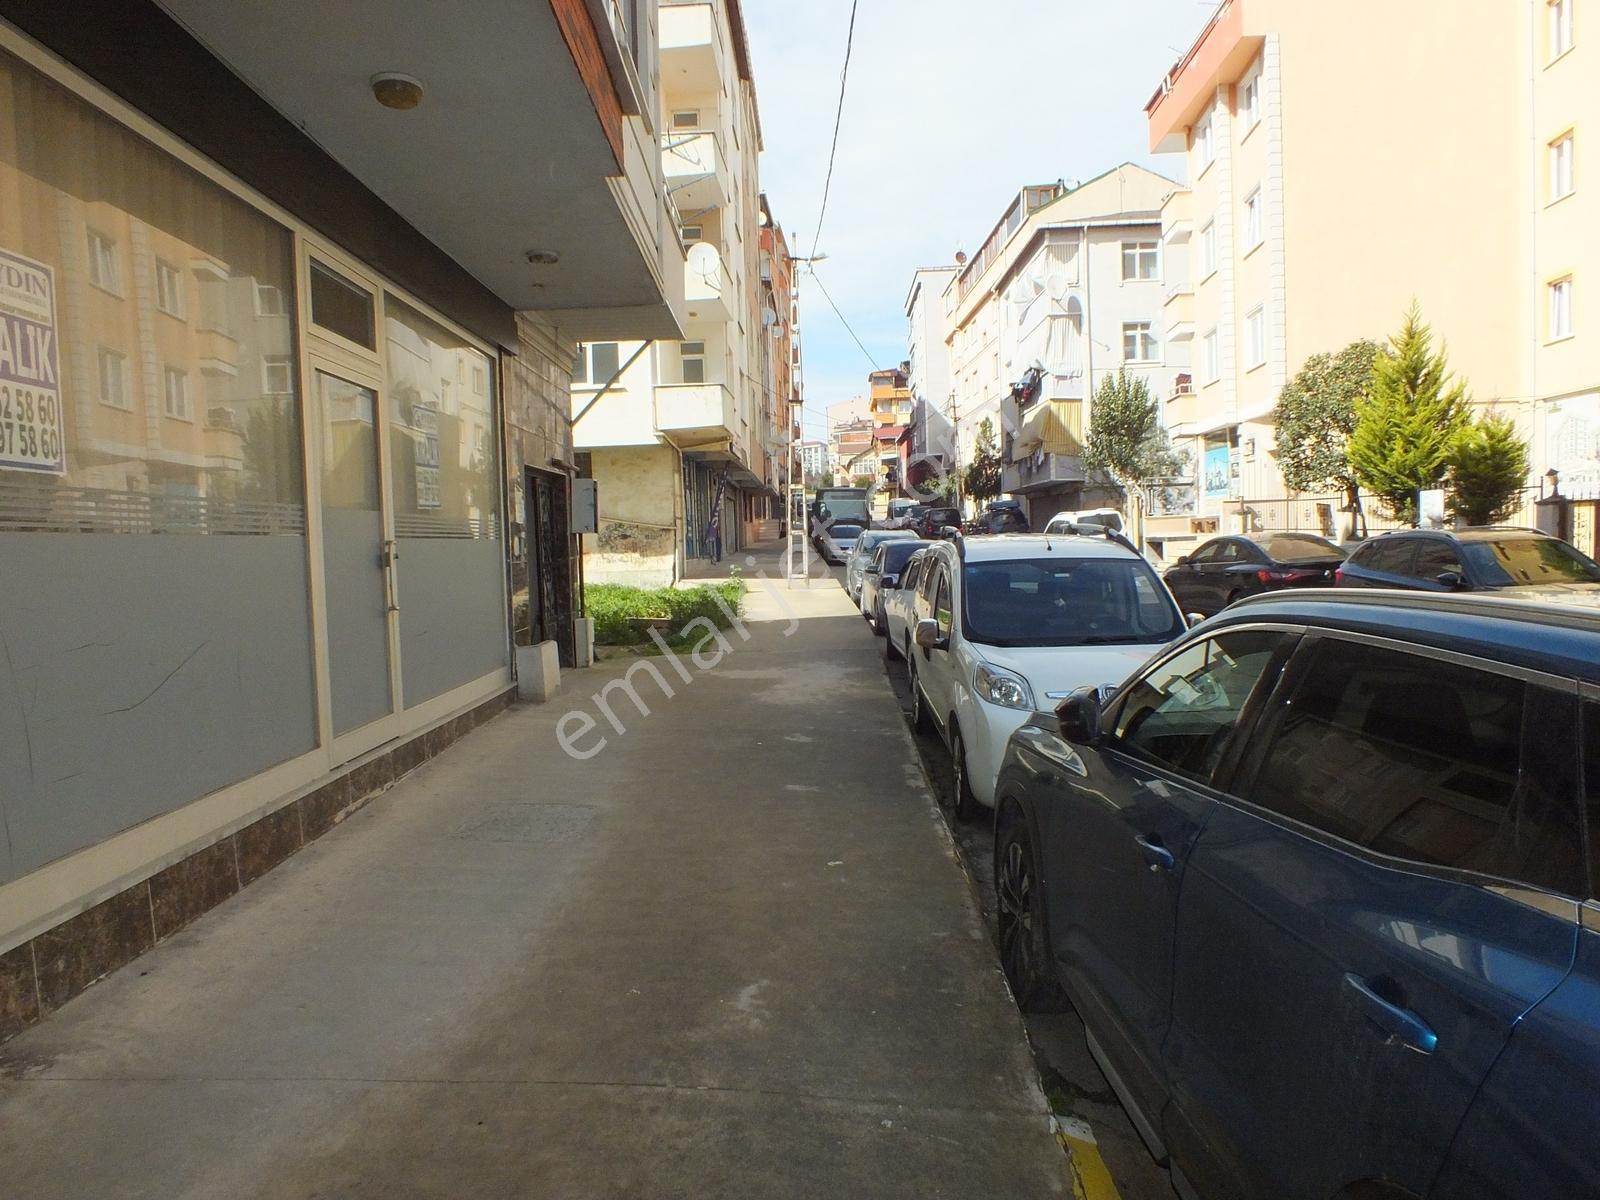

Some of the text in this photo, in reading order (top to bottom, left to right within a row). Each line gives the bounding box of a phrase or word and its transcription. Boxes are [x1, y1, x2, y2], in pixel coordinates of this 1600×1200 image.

[0, 385, 56, 427] 2 58 60
[19, 424, 37, 458] 58
[41, 427, 58, 460] 60
